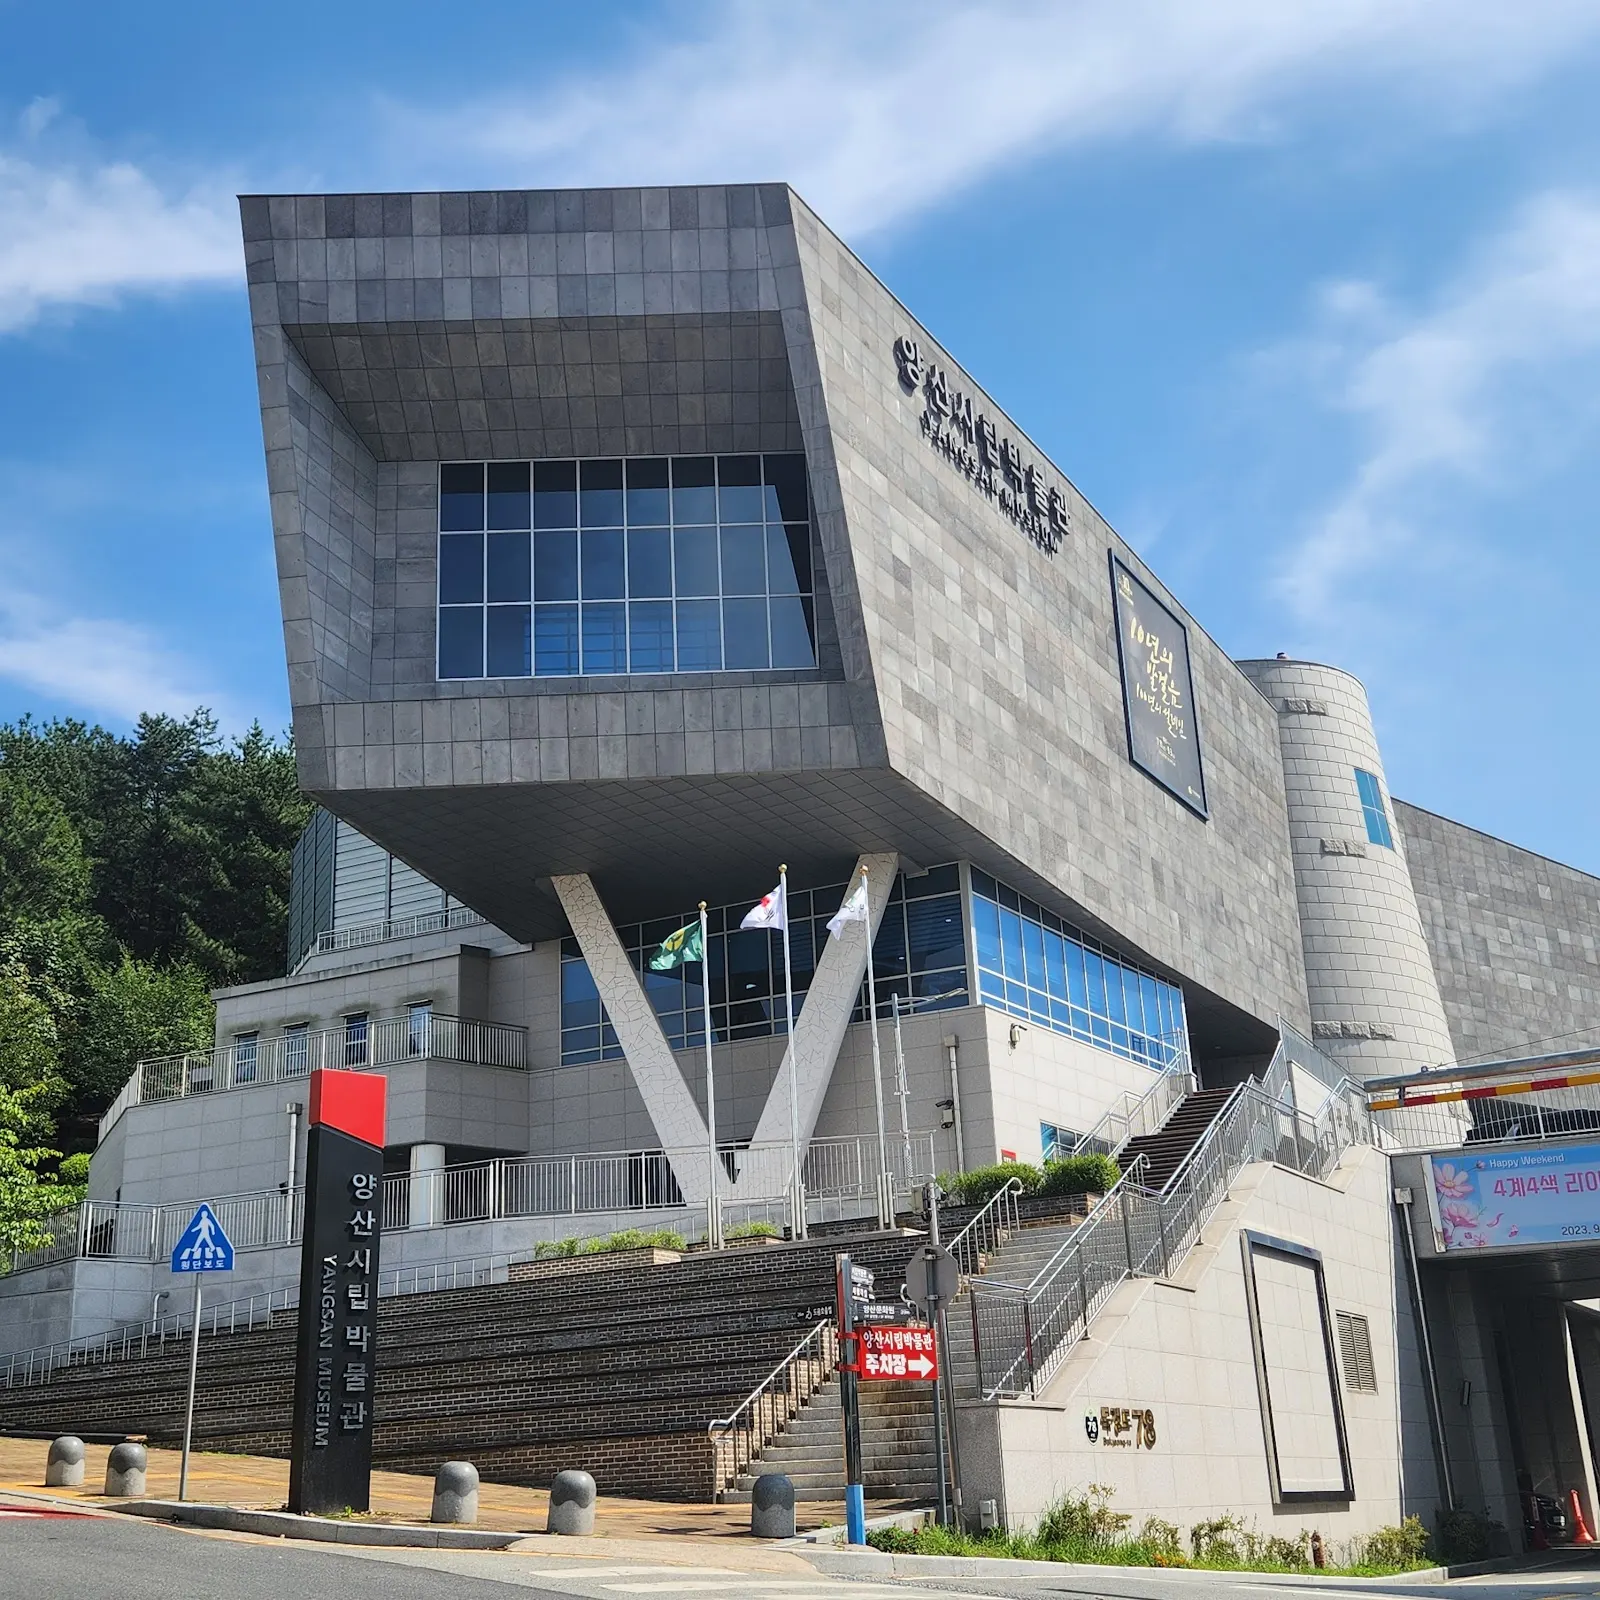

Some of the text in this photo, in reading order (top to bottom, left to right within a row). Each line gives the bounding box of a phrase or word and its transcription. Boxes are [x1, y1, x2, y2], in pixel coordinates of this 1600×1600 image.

[896, 335, 1070, 536] 양산시립박물관
[921, 410, 1058, 554] YANGSAN MUSEUM
[1130, 616, 1173, 674] 10년의
[1489, 1153, 1564, 1169] Happy Weekend
[1494, 1174, 1560, 1197] 4계4색
[180, 1259, 225, 1271] 횡단보도
[339, 1173, 378, 1430] 양산시립박물관
[863, 1304, 895, 1315] 양산문화원
[314, 1254, 338, 1446] YANGSAN MUSEUM
[863, 1330, 933, 1350] 양산시립박물관
[865, 1353, 906, 1375] 주차장
[1087, 1421, 1098, 1432] 78
[1131, 1408, 1157, 1450] 78
